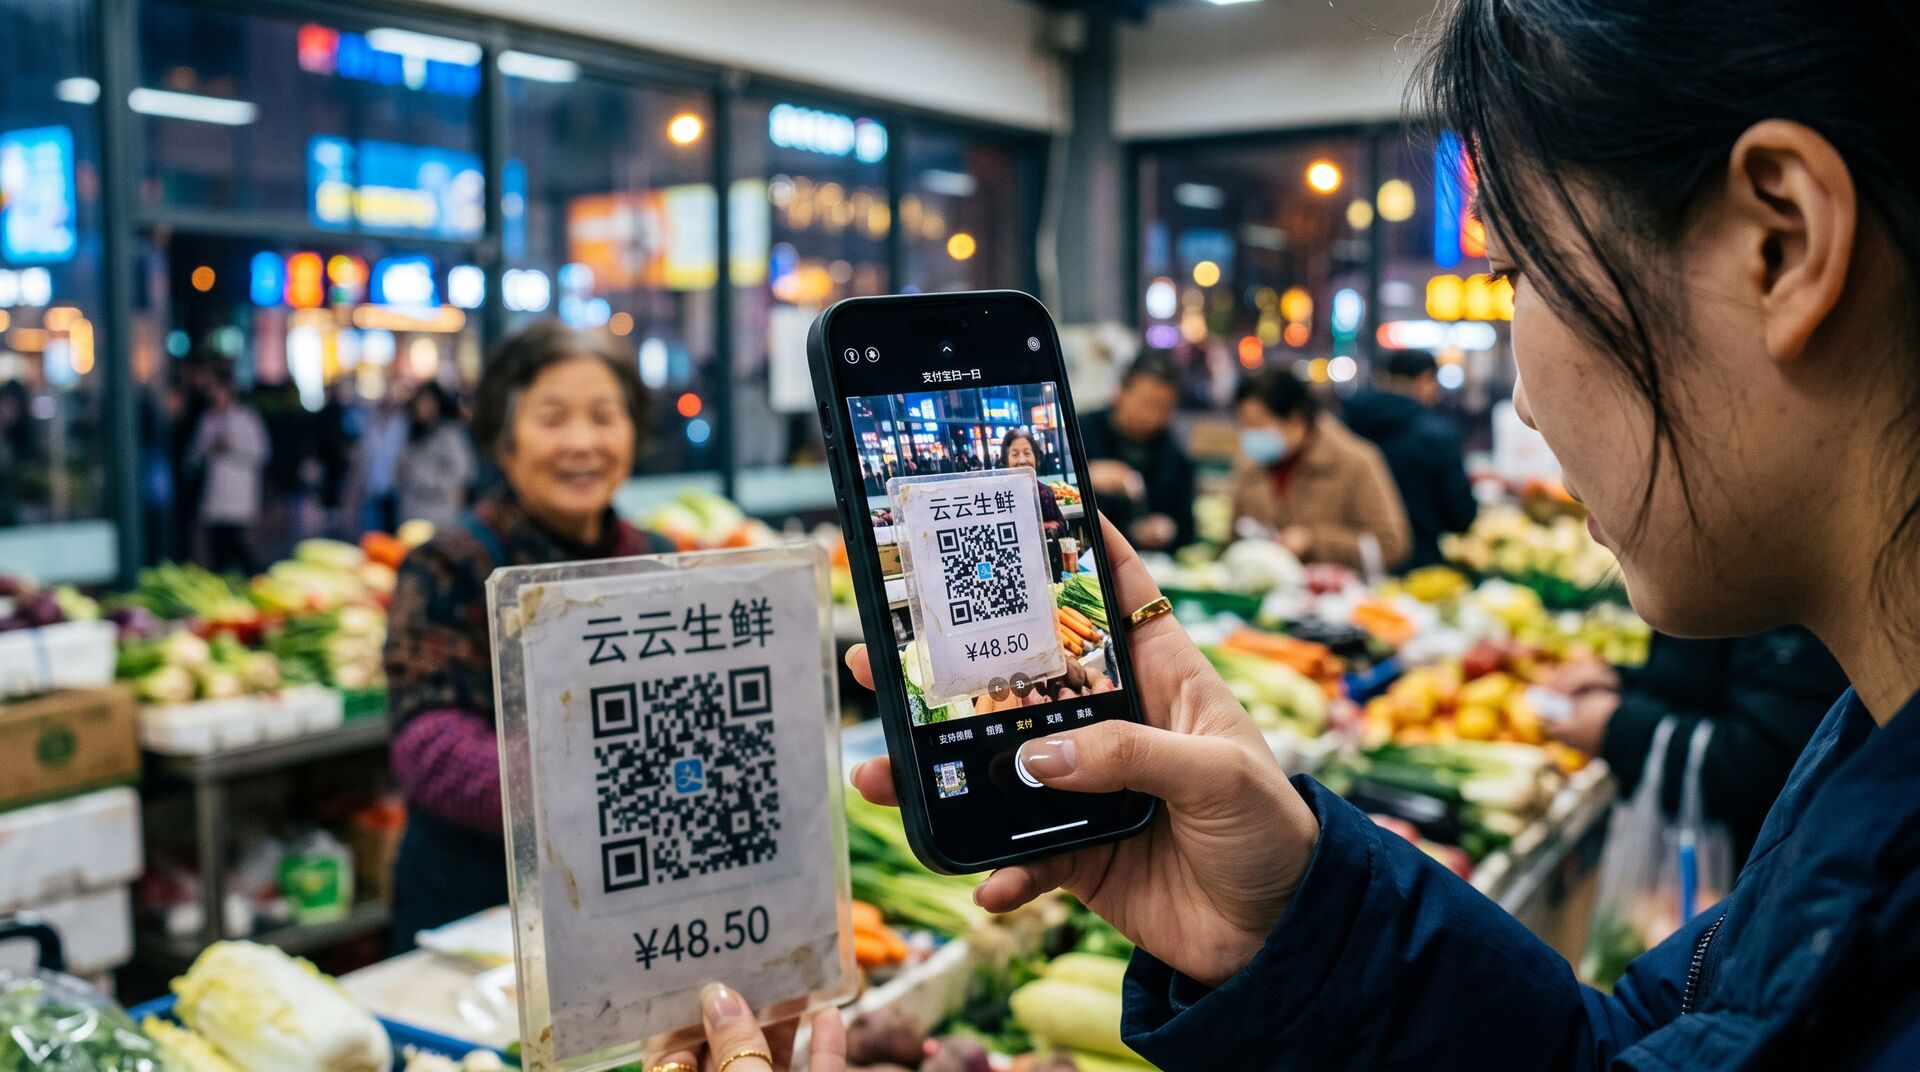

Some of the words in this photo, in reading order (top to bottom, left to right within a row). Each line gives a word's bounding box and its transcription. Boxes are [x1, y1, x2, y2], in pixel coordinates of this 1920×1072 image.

[929, 490, 1016, 522] 云云生鲜
[582, 595, 775, 666] 云云生鲜
[965, 632, 1029, 662] ¥48.50
[633, 905, 770, 970] ¥48.50
